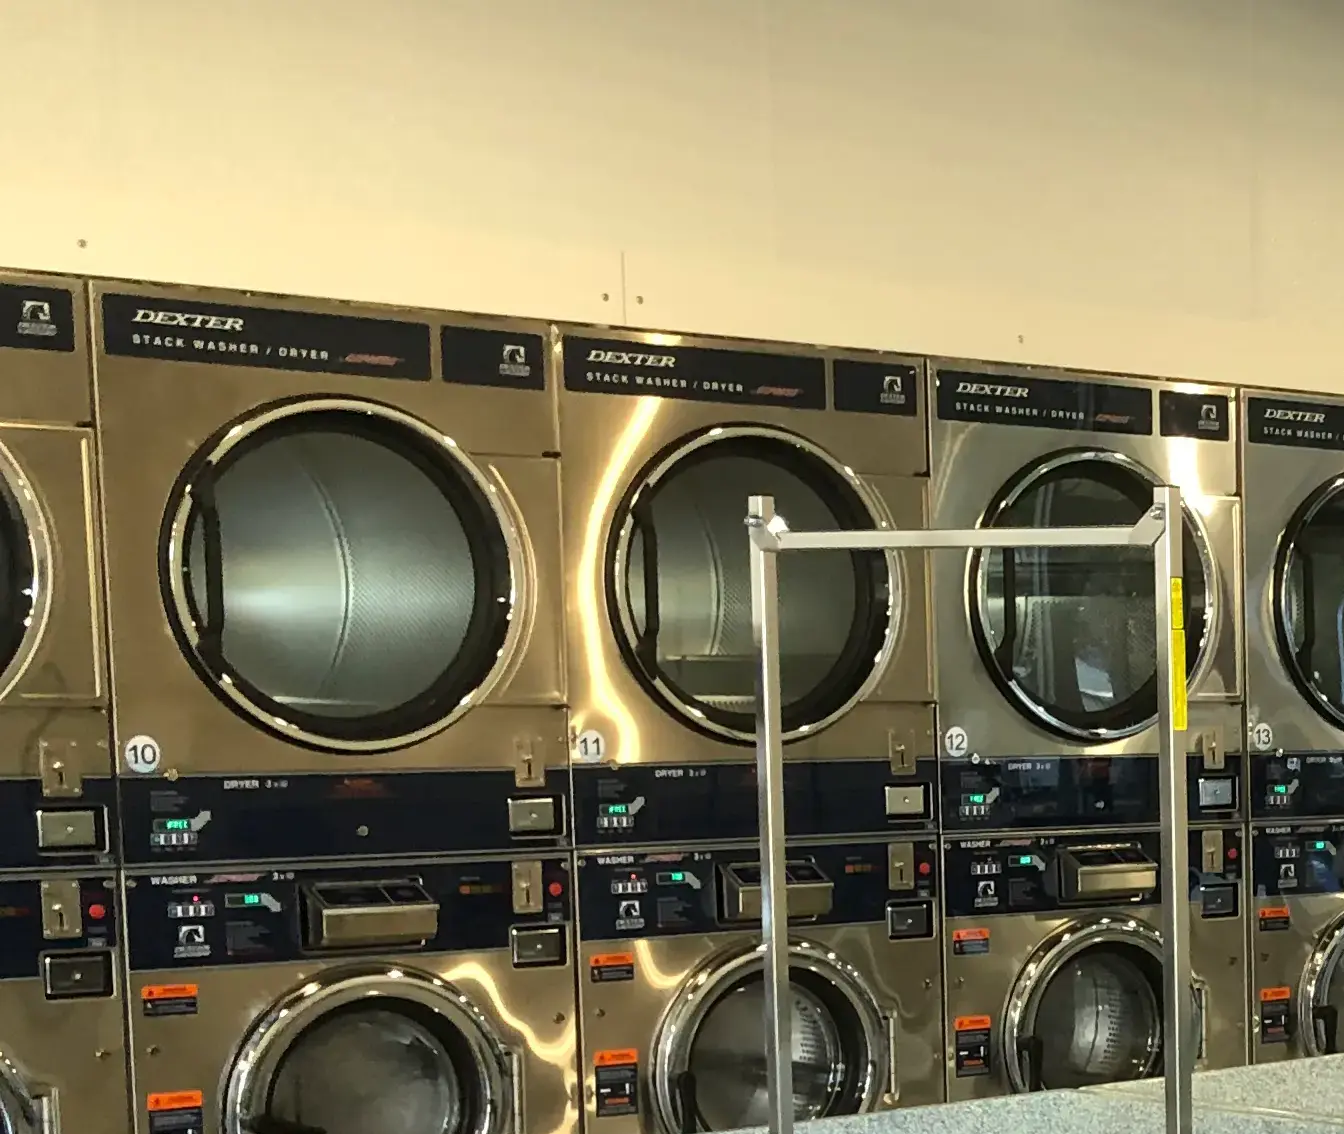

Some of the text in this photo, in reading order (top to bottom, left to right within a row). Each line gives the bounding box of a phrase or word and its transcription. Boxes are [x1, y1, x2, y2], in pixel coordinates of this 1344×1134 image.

[132, 310, 244, 331] DEXTER
[132, 334, 184, 347] STACK
[193, 340, 258, 354] WASHER
[279, 347, 329, 360] DRYER
[587, 350, 676, 367] DEXTER
[587, 372, 628, 384] STACK
[635, 376, 687, 388] WASHER
[703, 382, 743, 392] DRYER
[956, 383, 1029, 397] DEXTER
[956, 402, 989, 412] STACK
[996, 406, 1038, 416] WASHER
[1052, 410, 1084, 420] DRYER
[1264, 409, 1325, 423] DEXTER
[947, 734, 965, 750] 12
[1255, 729, 1271, 745] 13
[128, 744, 156, 764] 10
[580, 737, 600, 755] 11
[224, 780, 259, 789] DRYER
[960, 840, 990, 848] WASHER
[597, 855, 634, 864] WASHER
[150, 875, 198, 885] WASHER
